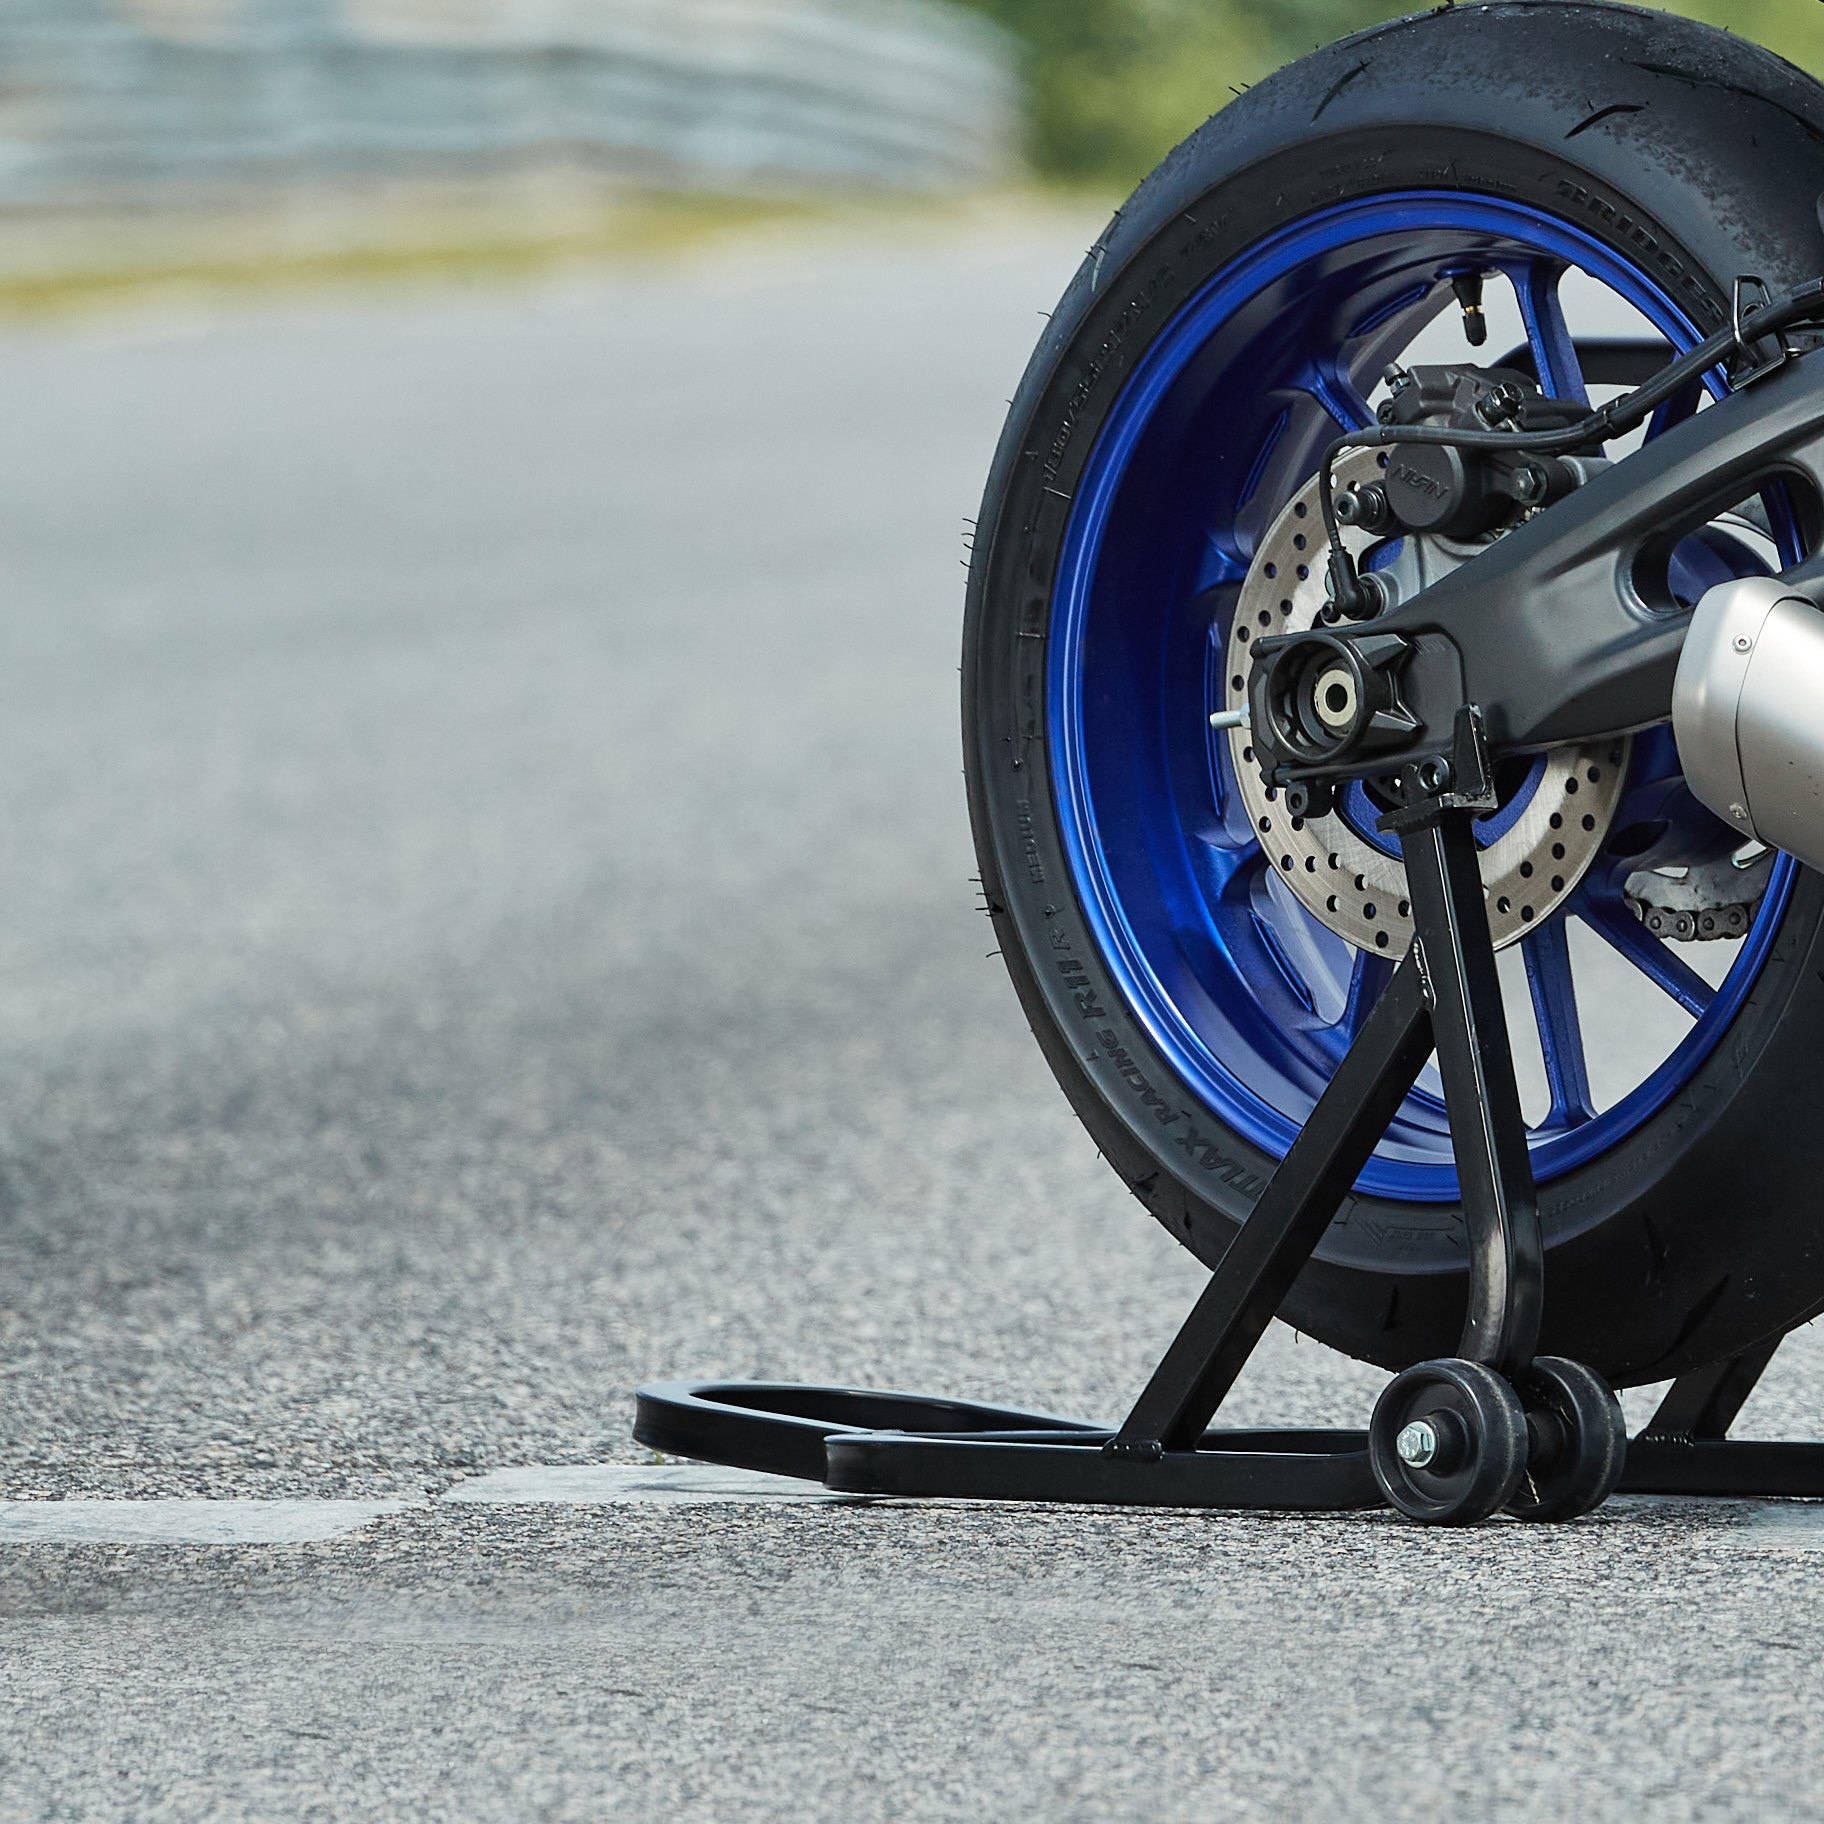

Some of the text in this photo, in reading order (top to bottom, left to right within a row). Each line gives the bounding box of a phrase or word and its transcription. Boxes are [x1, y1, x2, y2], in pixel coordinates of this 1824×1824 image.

[1555, 178, 1730, 328] BRIDGES
[1057, 958, 1106, 1020] R11
[1101, 1027, 1179, 1128] RACING
[1176, 1131, 1269, 1202] TTLAX
